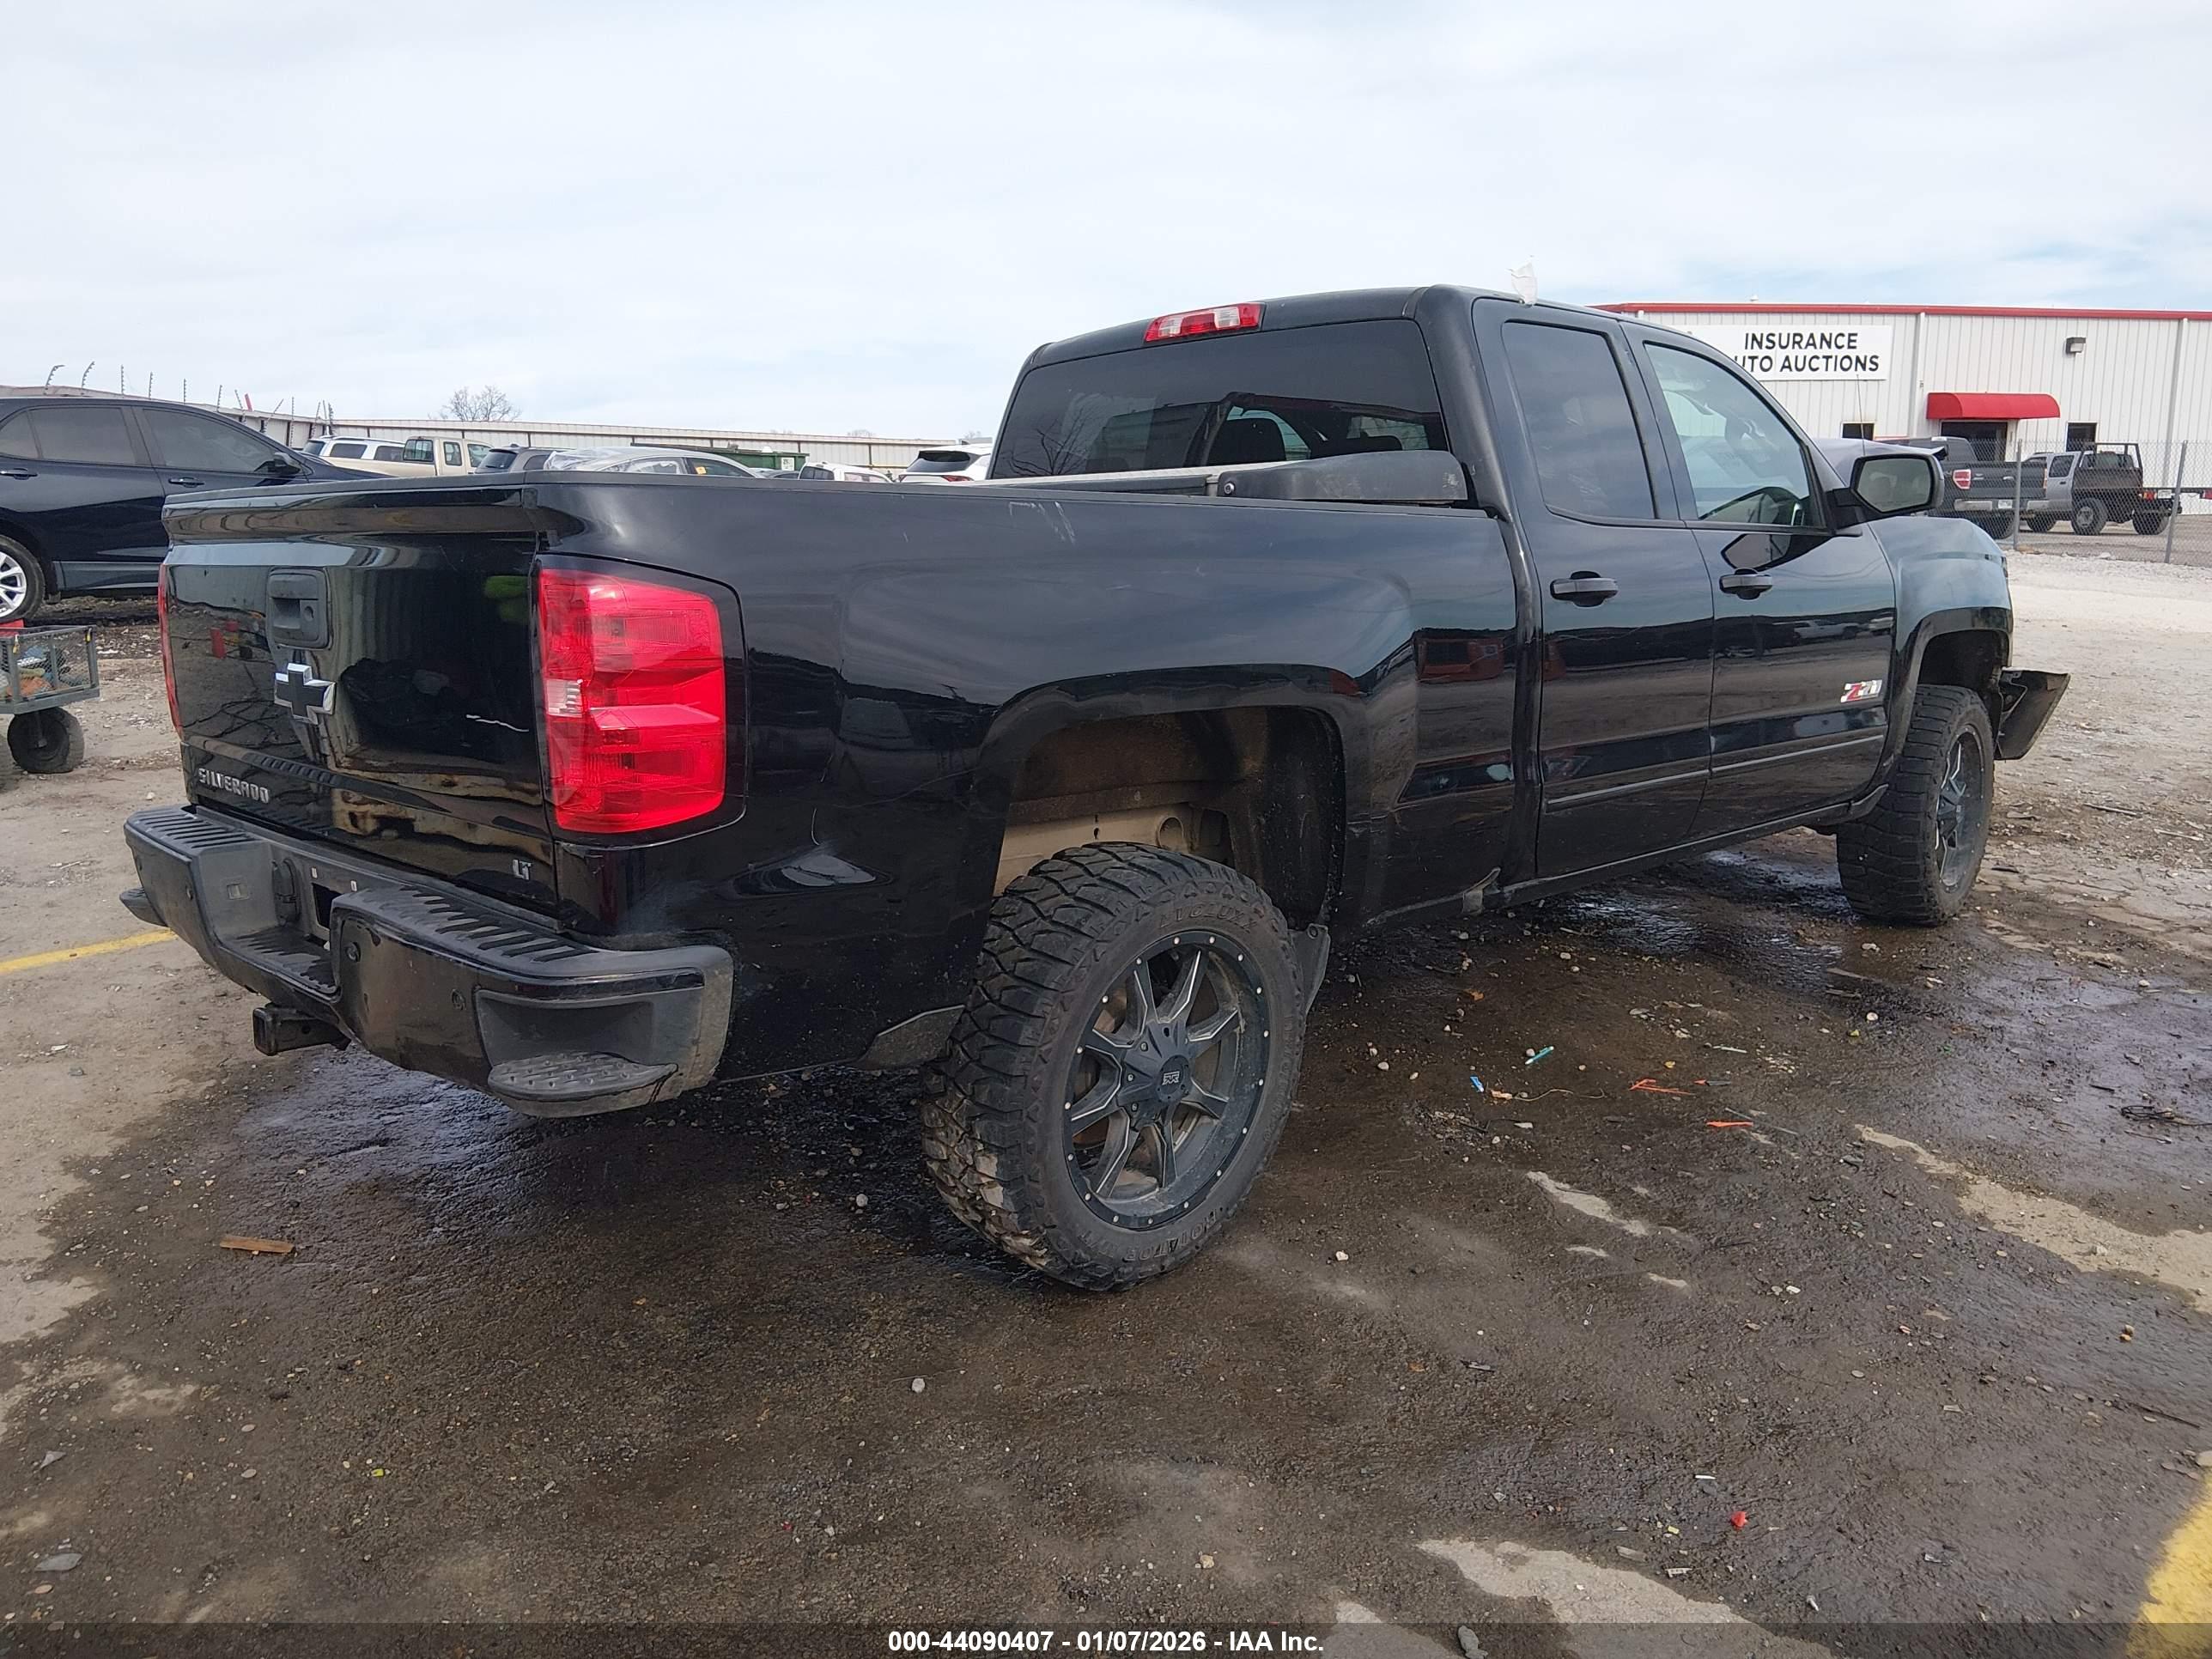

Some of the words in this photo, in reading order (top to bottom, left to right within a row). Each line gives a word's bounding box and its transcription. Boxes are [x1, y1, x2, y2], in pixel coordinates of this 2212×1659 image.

[1744, 332, 1858, 349] INSURANCE
[1779, 355, 1880, 372] AUCTIONS
[1840, 679, 1883, 703] Z71
[198, 768, 270, 804] SILVERADO
[512, 859, 532, 880] LT
